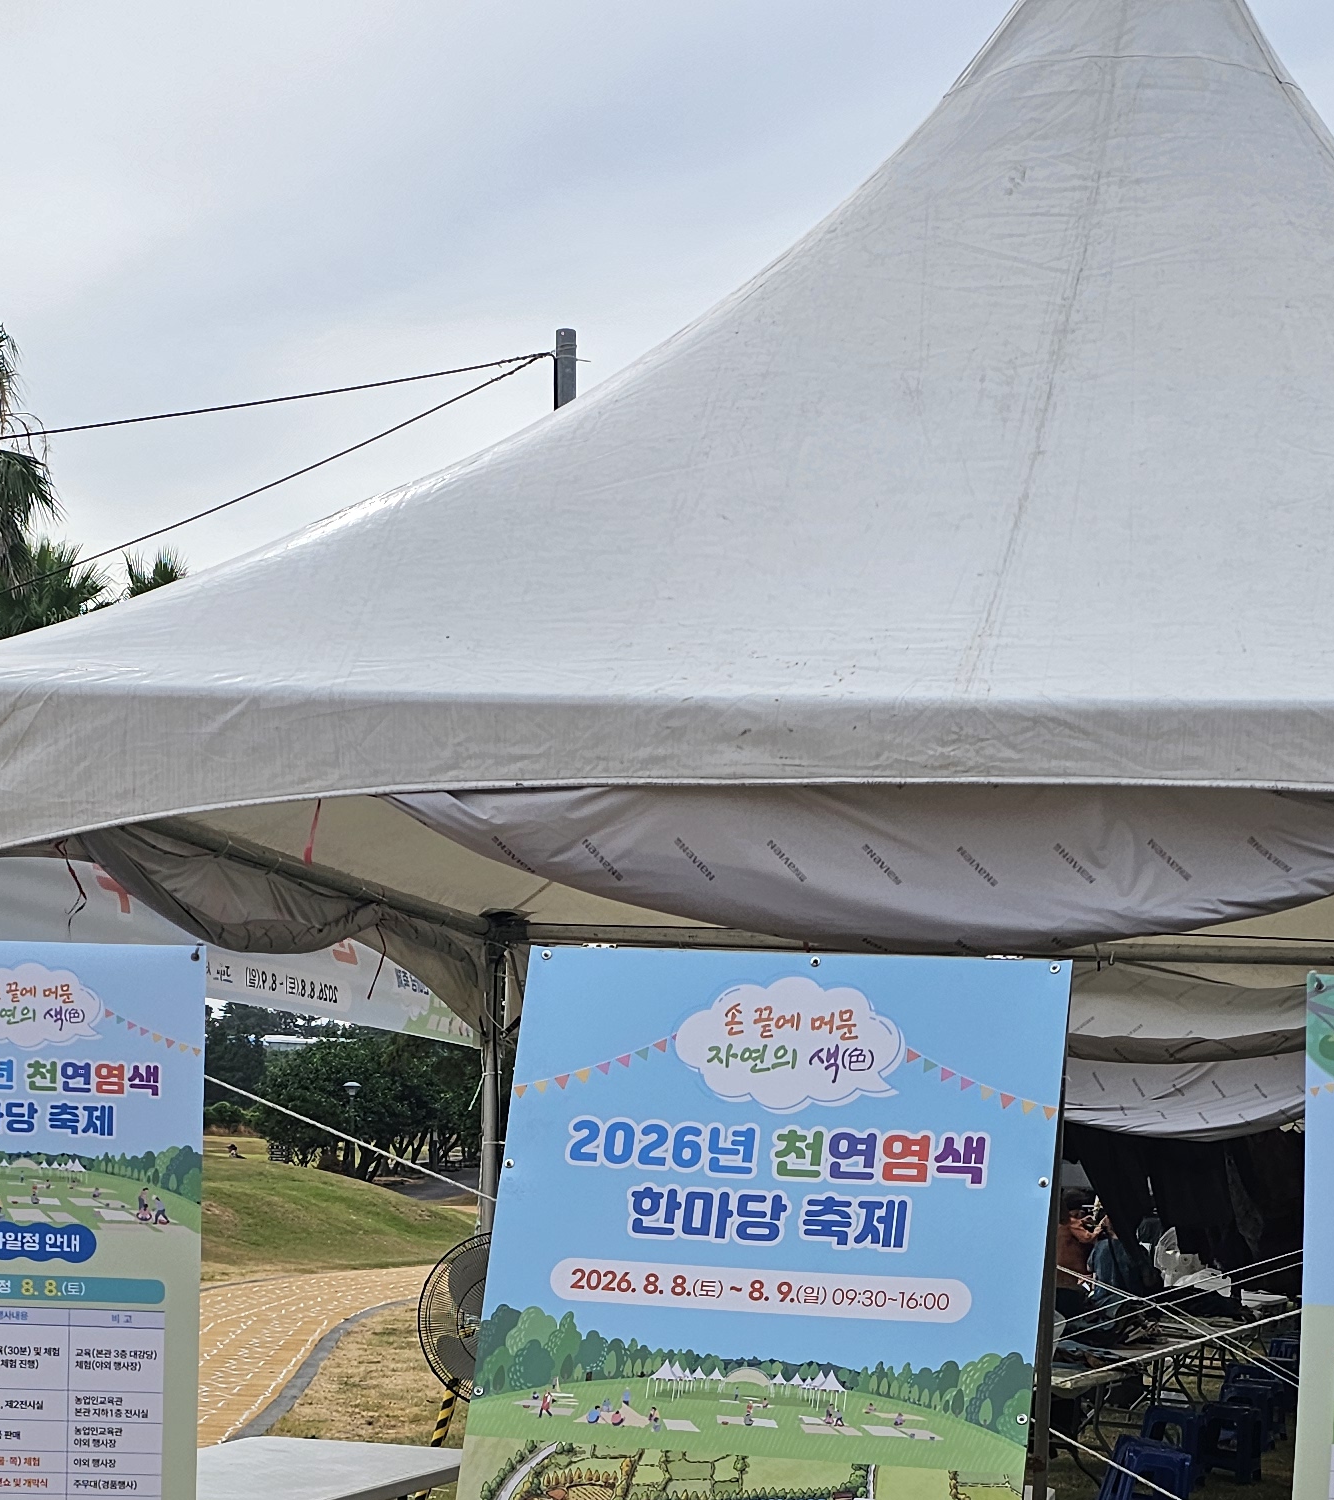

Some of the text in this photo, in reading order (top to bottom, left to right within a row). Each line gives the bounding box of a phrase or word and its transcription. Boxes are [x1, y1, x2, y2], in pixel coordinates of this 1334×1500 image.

[724, 1003, 858, 1041] 손 끝에 머문
[708, 1045, 797, 1073] 자연의
[26, 1061, 160, 1096] 천연염색
[48, 1103, 114, 1137] 축제
[569, 1119, 986, 1187] 2026년 천연염색
[630, 1187, 910, 1250] 한마당 축제
[45, 1235, 80, 1252] 안내
[570, 1268, 636, 1294] 2026.
[643, 1273, 665, 1297] 8.
[748, 1281, 770, 1303] 8.
[833, 1288, 950, 1311] 09:30~16:00
[75, 1348, 110, 1360] 교육(본관
